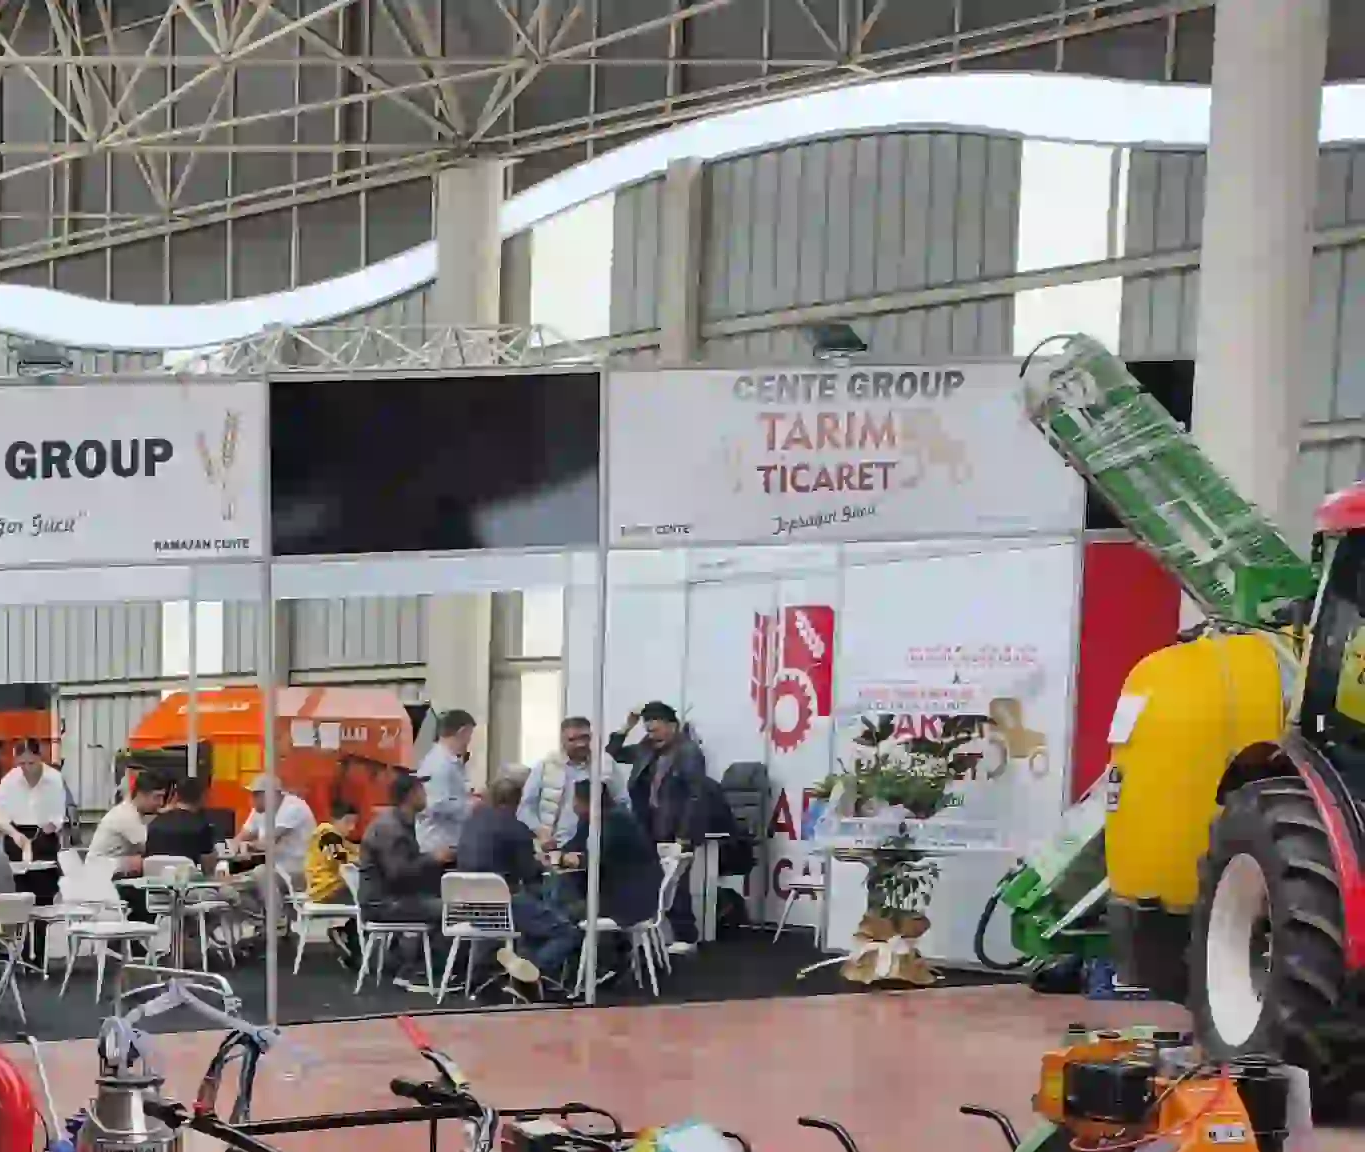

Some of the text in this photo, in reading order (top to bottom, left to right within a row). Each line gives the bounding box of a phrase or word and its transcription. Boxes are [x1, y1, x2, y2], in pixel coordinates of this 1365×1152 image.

[733, 371, 966, 403] CENTE GROUP
[757, 411, 899, 452] TARIM
[4, 438, 174, 481] GROUP
